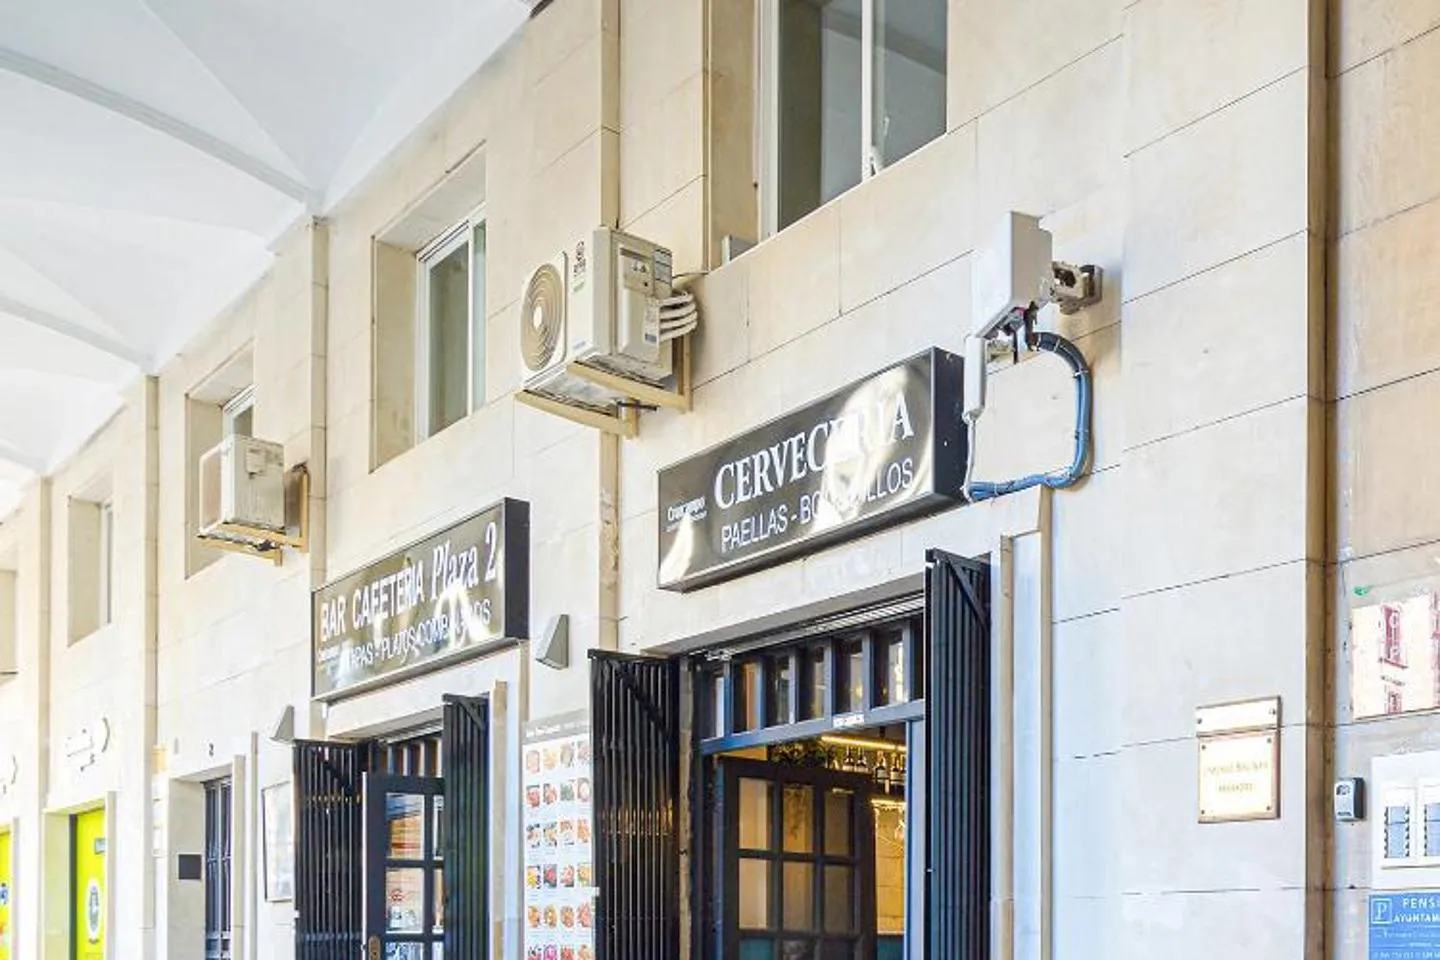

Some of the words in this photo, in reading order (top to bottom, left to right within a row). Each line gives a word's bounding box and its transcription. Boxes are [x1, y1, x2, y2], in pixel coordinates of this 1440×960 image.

[720, 504, 789, 553] PAELLAS
[801, 457, 914, 526] BOLLOS
[320, 595, 347, 642] BAR
[430, 540, 479, 601] Plaza
[484, 521, 498, 583] 2
[344, 642, 374, 672] APAS
[1375, 901, 1388, 920] P
